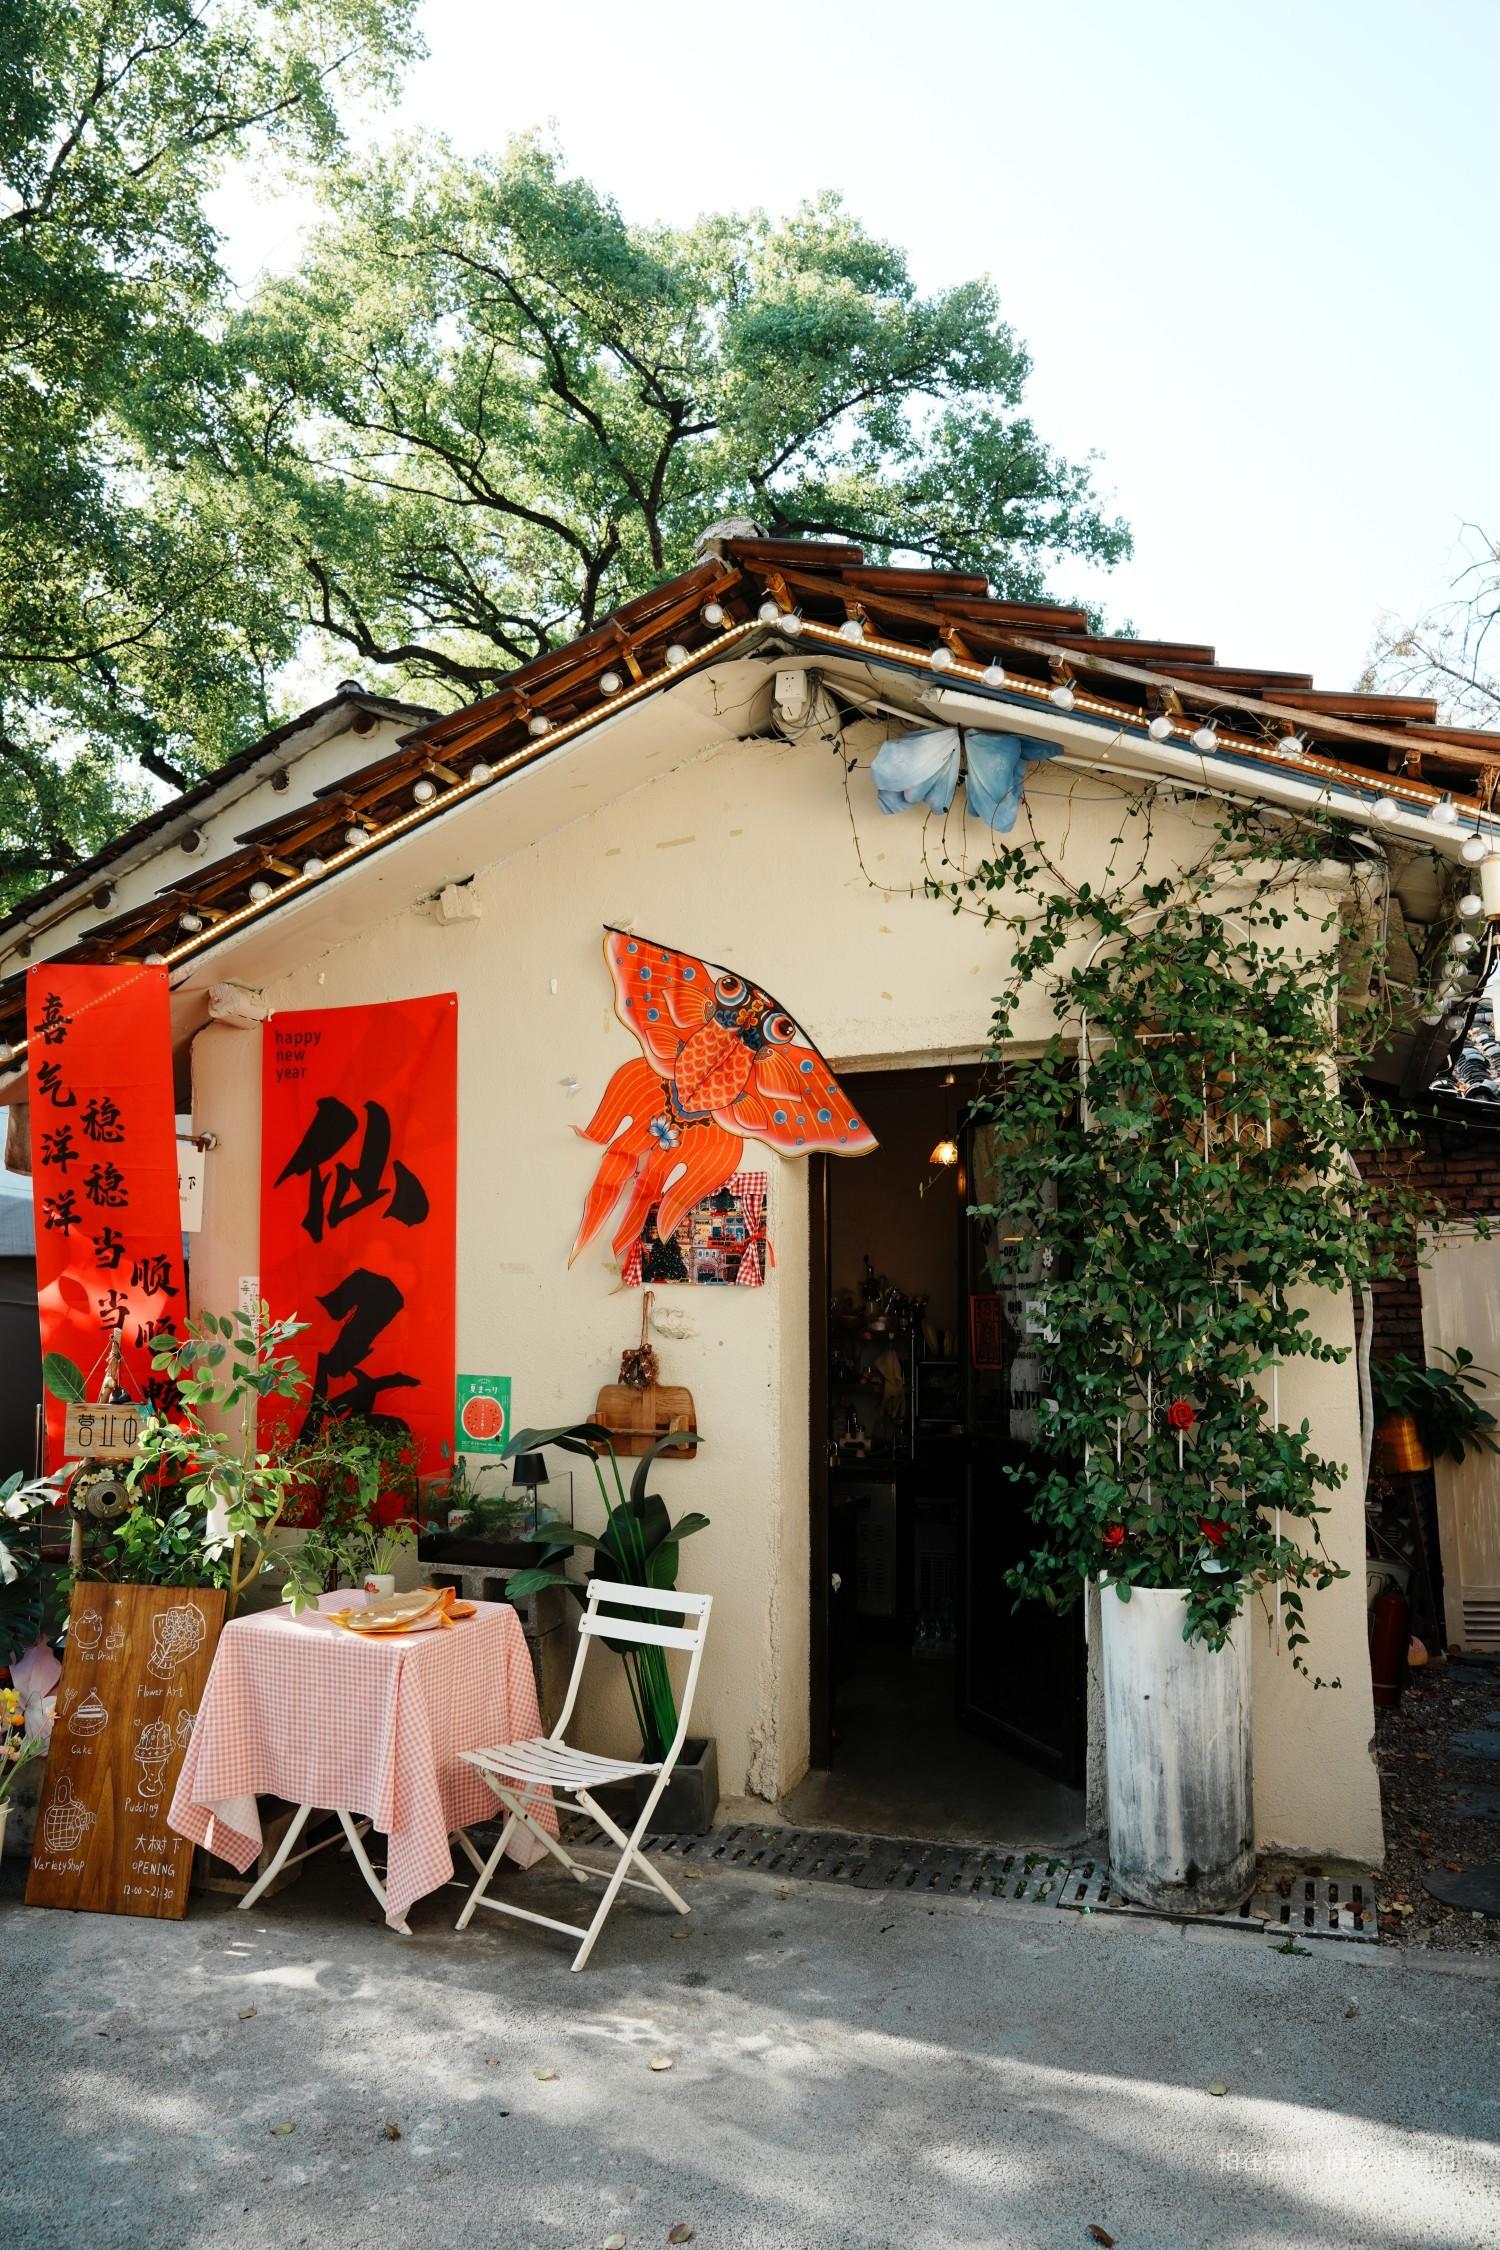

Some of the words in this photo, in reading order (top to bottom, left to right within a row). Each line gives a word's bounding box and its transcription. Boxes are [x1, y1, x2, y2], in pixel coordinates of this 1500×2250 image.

[275, 1030, 321, 1046] happy
[276, 1050, 305, 1062] new
[275, 1067, 307, 1083] year
[33, 991, 82, 1238] 喜气洋洋
[80, 1097, 128, 1332] 稳稳当当
[81, 1651, 94, 1661] Tea
[137, 1684, 164, 1697] Flower
[166, 1685, 183, 1698] Art
[124, 1797, 160, 1818] Pudding
[132, 1859, 176, 1877] OPENING
